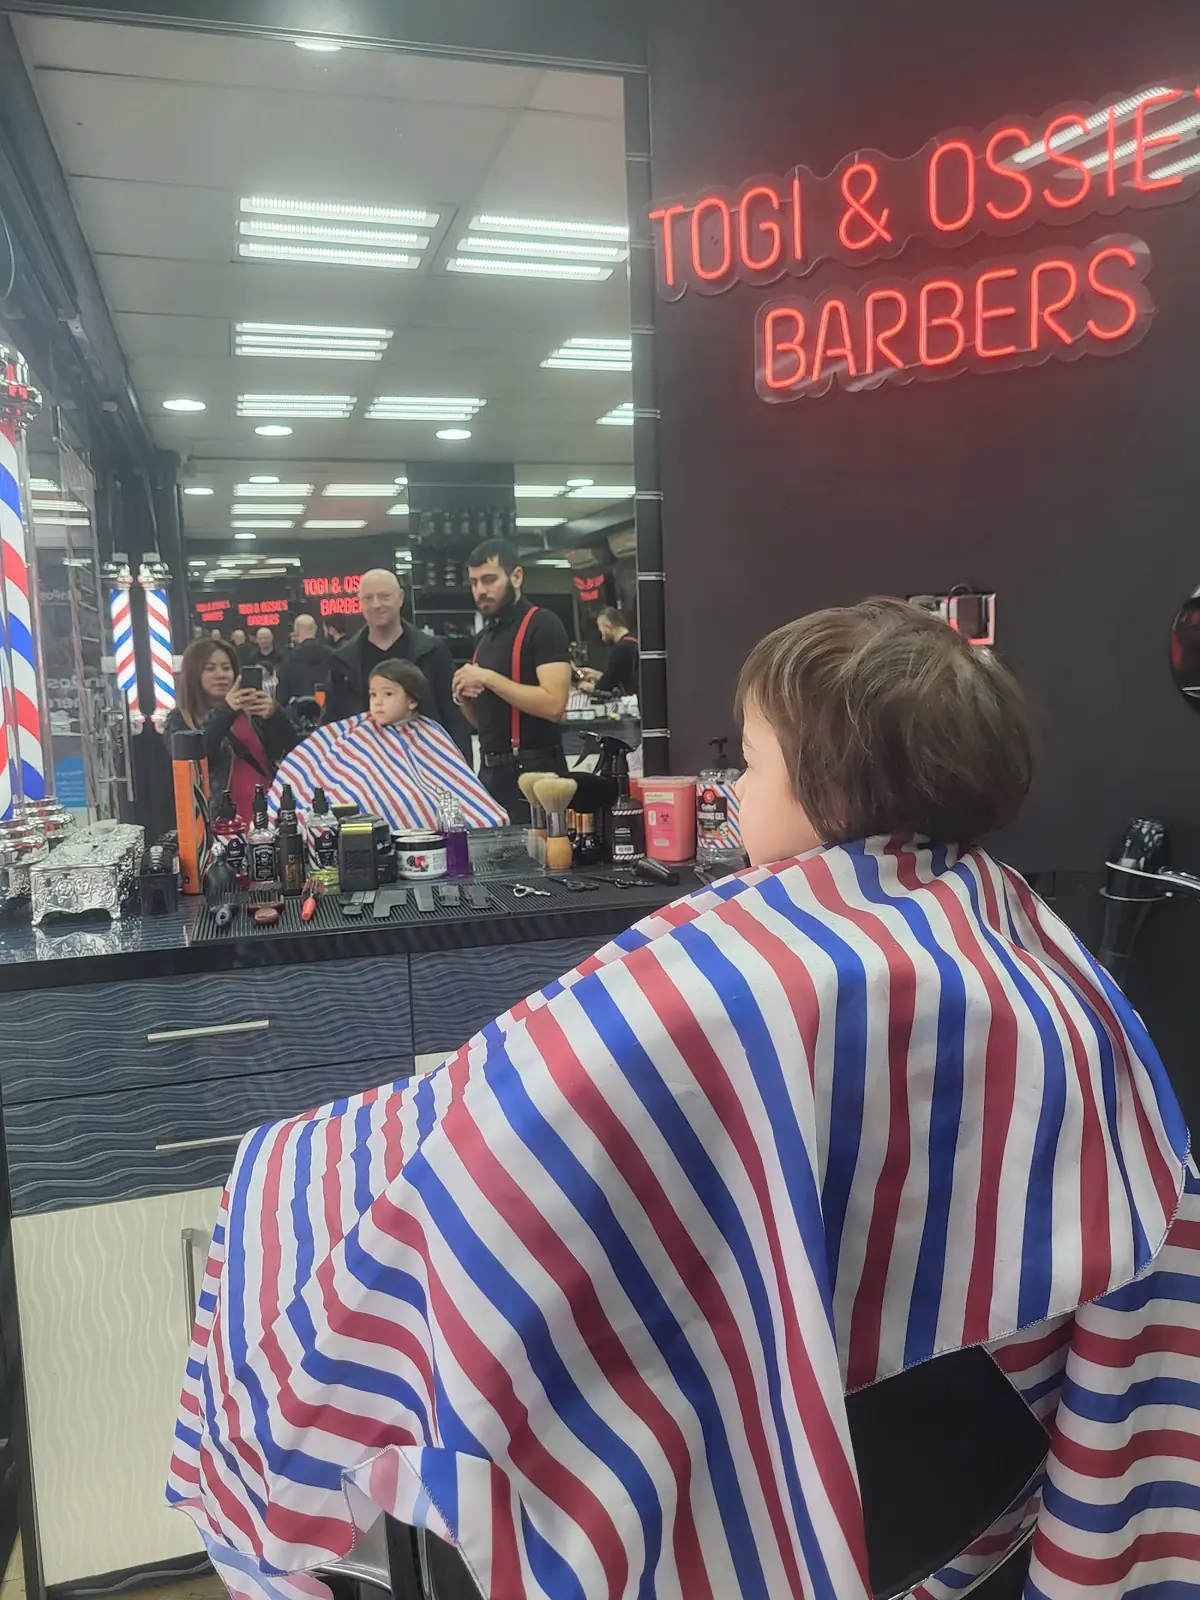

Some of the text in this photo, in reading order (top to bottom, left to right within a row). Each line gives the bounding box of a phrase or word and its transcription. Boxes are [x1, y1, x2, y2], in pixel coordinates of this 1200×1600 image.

[648, 178, 803, 285] TOGI
[838, 162, 893, 250] &
[763, 247, 1138, 389] BARBERS
[320, 597, 364, 616] BARBE
